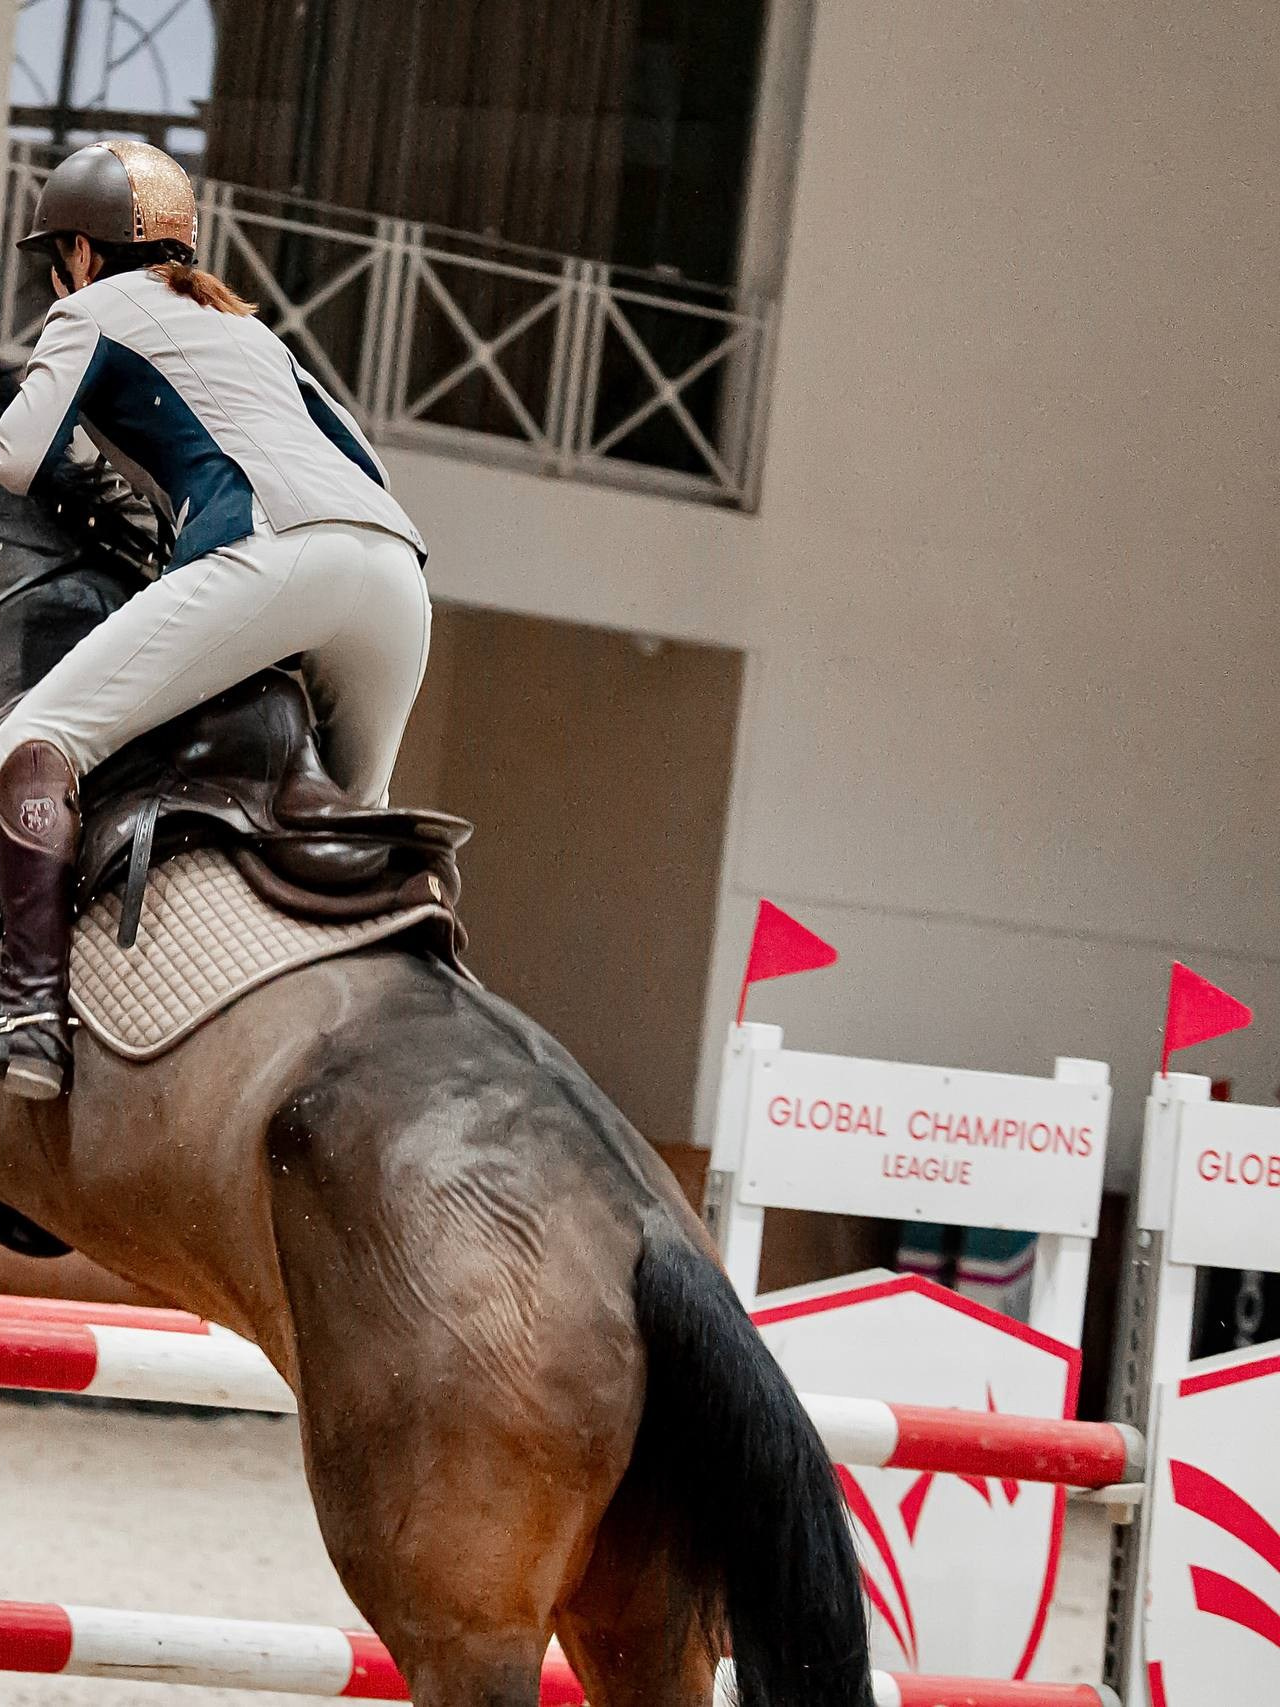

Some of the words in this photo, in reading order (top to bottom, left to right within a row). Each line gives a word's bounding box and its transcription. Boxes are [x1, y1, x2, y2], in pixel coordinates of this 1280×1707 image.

[768, 1095, 886, 1138] GLOBAL
[908, 1109, 1093, 1158] CHAMPIONS
[882, 1154, 972, 1186] LEAGUE
